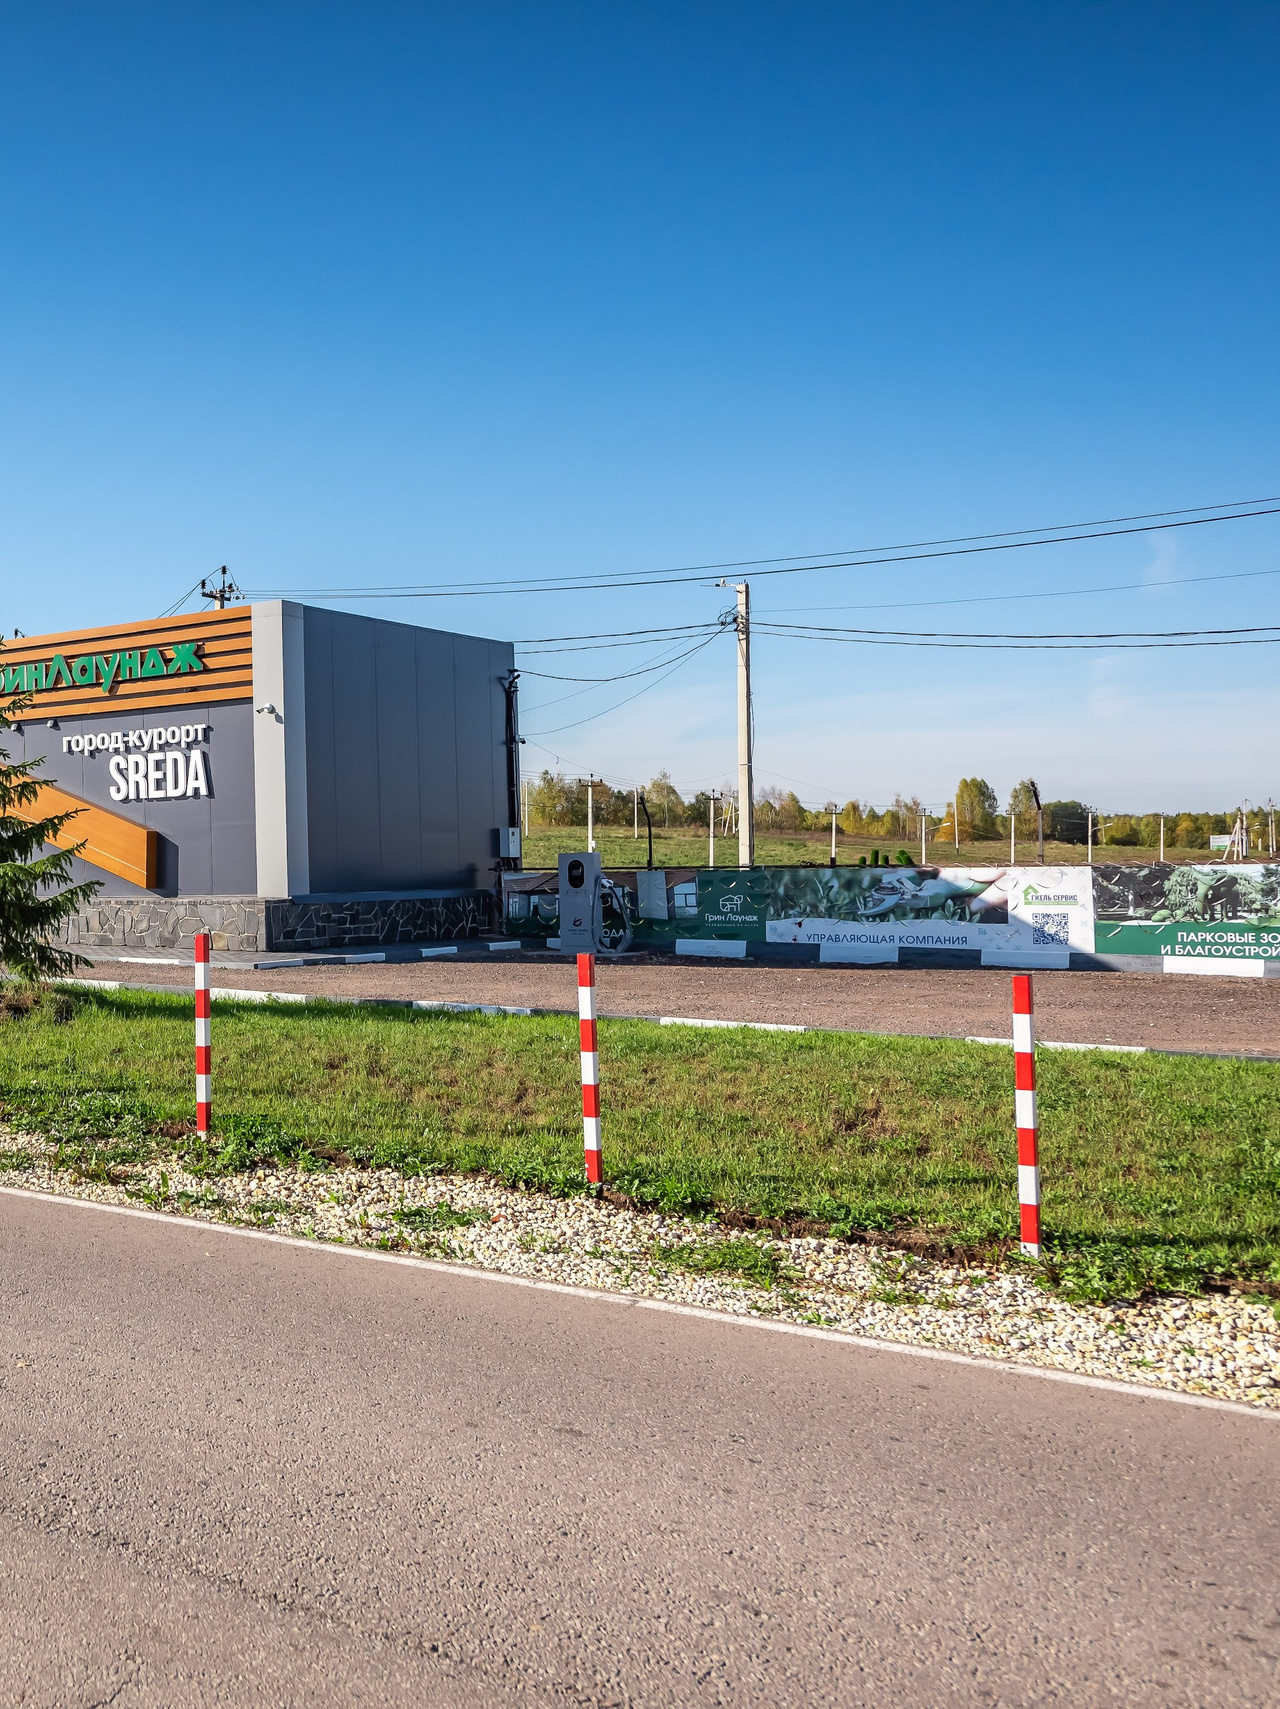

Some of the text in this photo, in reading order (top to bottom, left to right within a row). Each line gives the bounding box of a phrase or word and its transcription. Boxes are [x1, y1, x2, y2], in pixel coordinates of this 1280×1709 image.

[62, 724, 206, 756] город-курорт
[109, 749, 208, 800] SREDA
[705, 913, 759, 923] Грин Лаундж
[806, 933, 968, 946] УПРАВЛЯЮЩАЯ КОМПАНИЯ
[1177, 932, 1256, 943] ПАРКОВЫЕ
[1161, 944, 1280, 957] И БЛАГОУСТРОЙ
